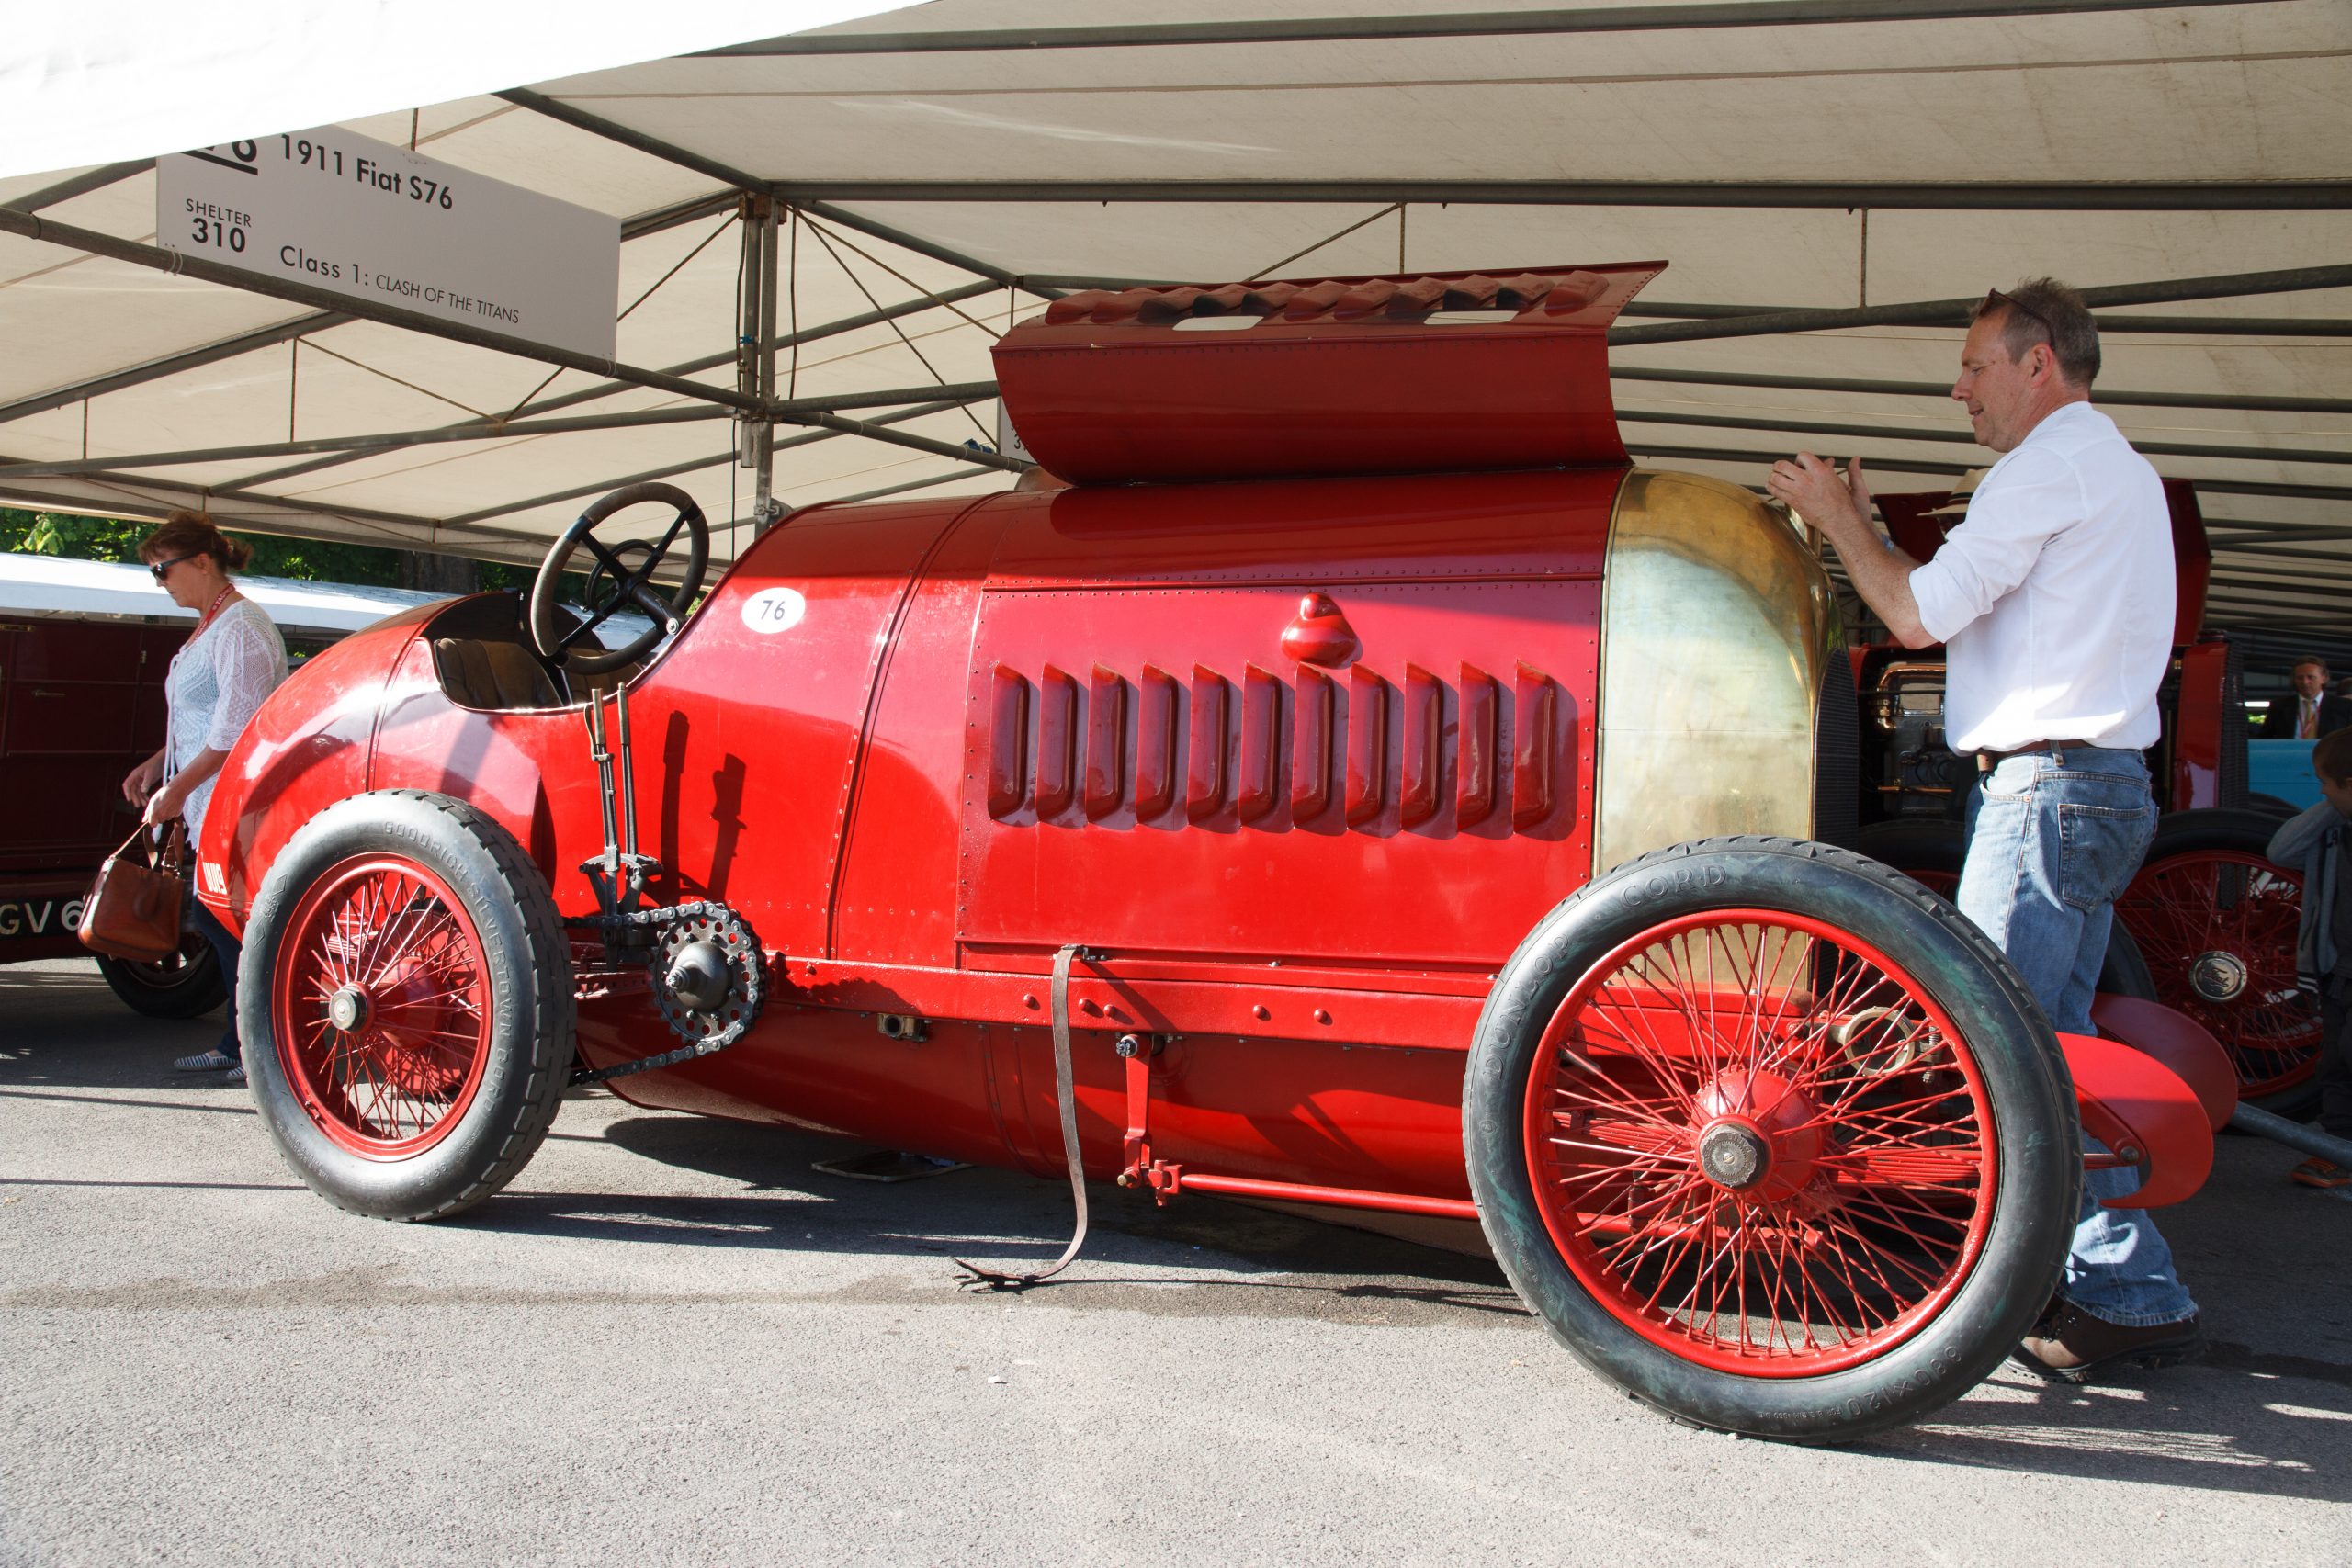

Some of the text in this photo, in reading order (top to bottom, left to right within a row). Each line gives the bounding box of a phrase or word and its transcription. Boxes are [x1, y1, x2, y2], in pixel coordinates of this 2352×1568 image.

[281, 133, 453, 210] 1911 Fiat S76
[186, 198, 252, 229] SHELTER
[191, 217, 246, 253] 310
[279, 245, 520, 324] Class 1: CLASH OF THE TITANS
[761, 599, 786, 621] 76
[1620, 865, 1727, 908] CORD
[384, 821, 513, 1118] GOODRICH SILVERTOWN CORD
[1483, 935, 1570, 1082] DUNLOP
